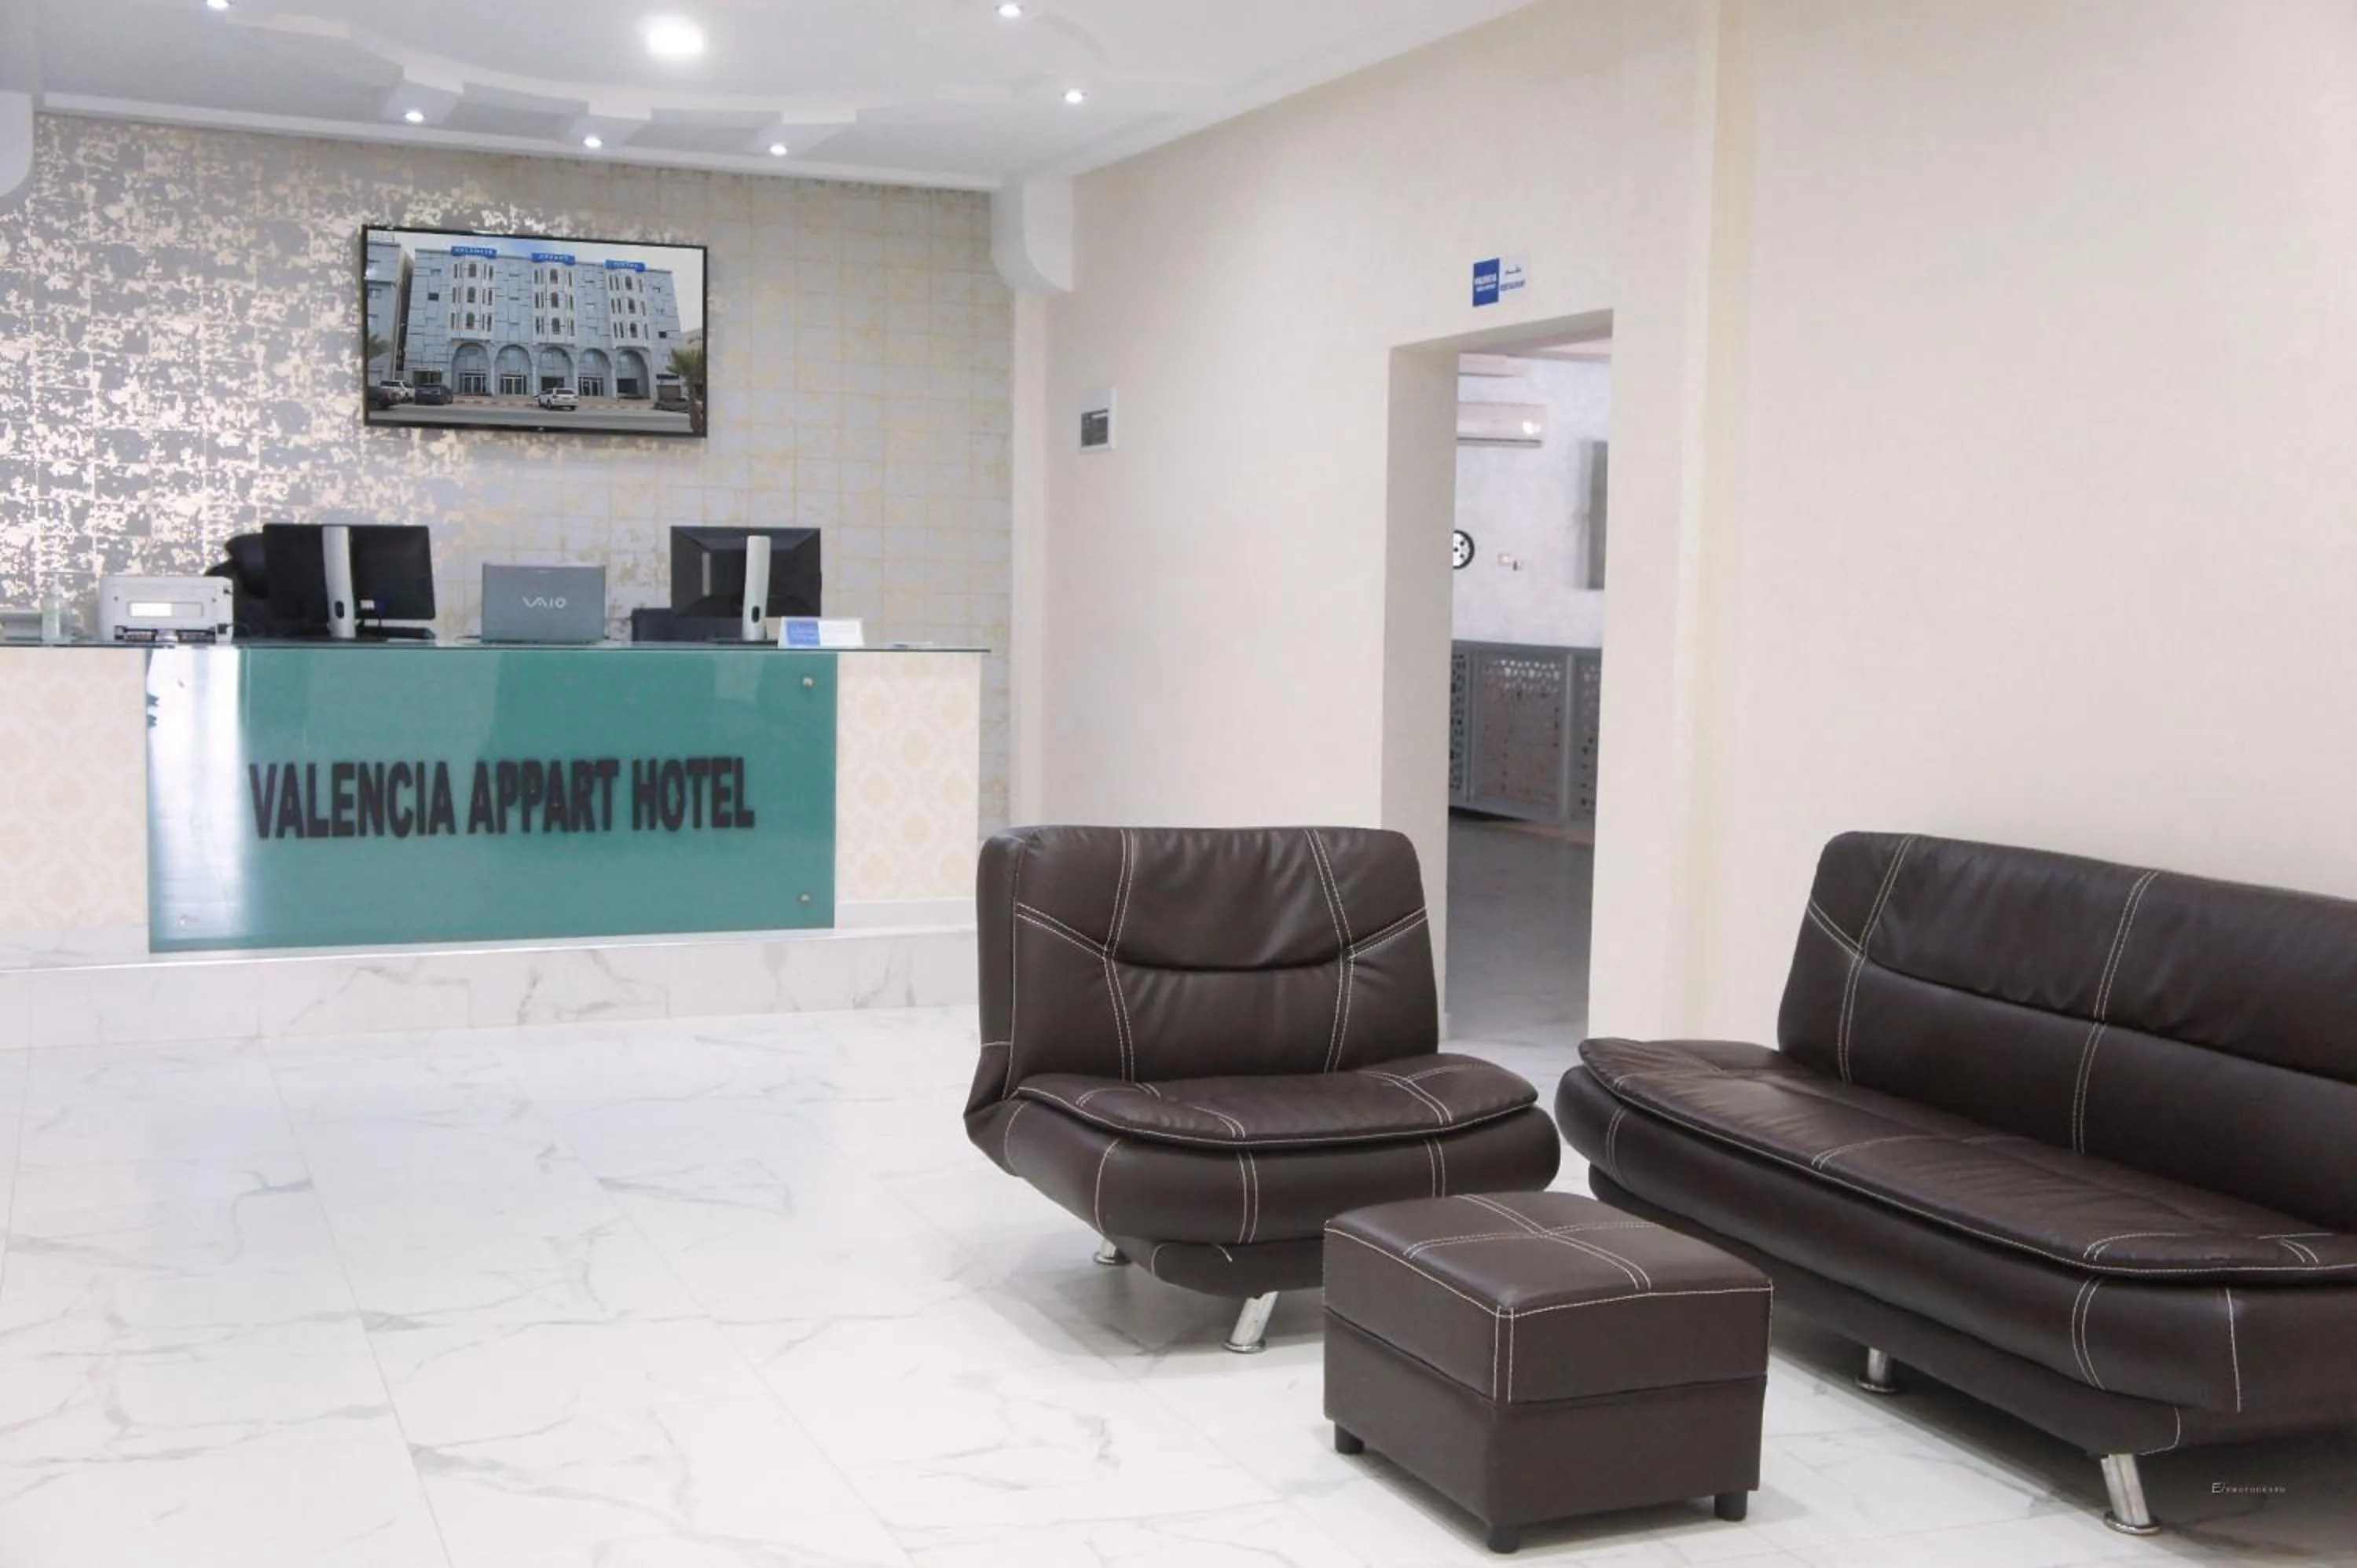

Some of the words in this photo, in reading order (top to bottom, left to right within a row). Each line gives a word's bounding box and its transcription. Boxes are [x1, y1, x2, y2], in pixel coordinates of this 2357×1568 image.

[521, 595, 567, 609] VAIO
[250, 760, 456, 839] VALENCIA
[467, 757, 621, 835] APPART
[631, 756, 756, 833] HOTEL
